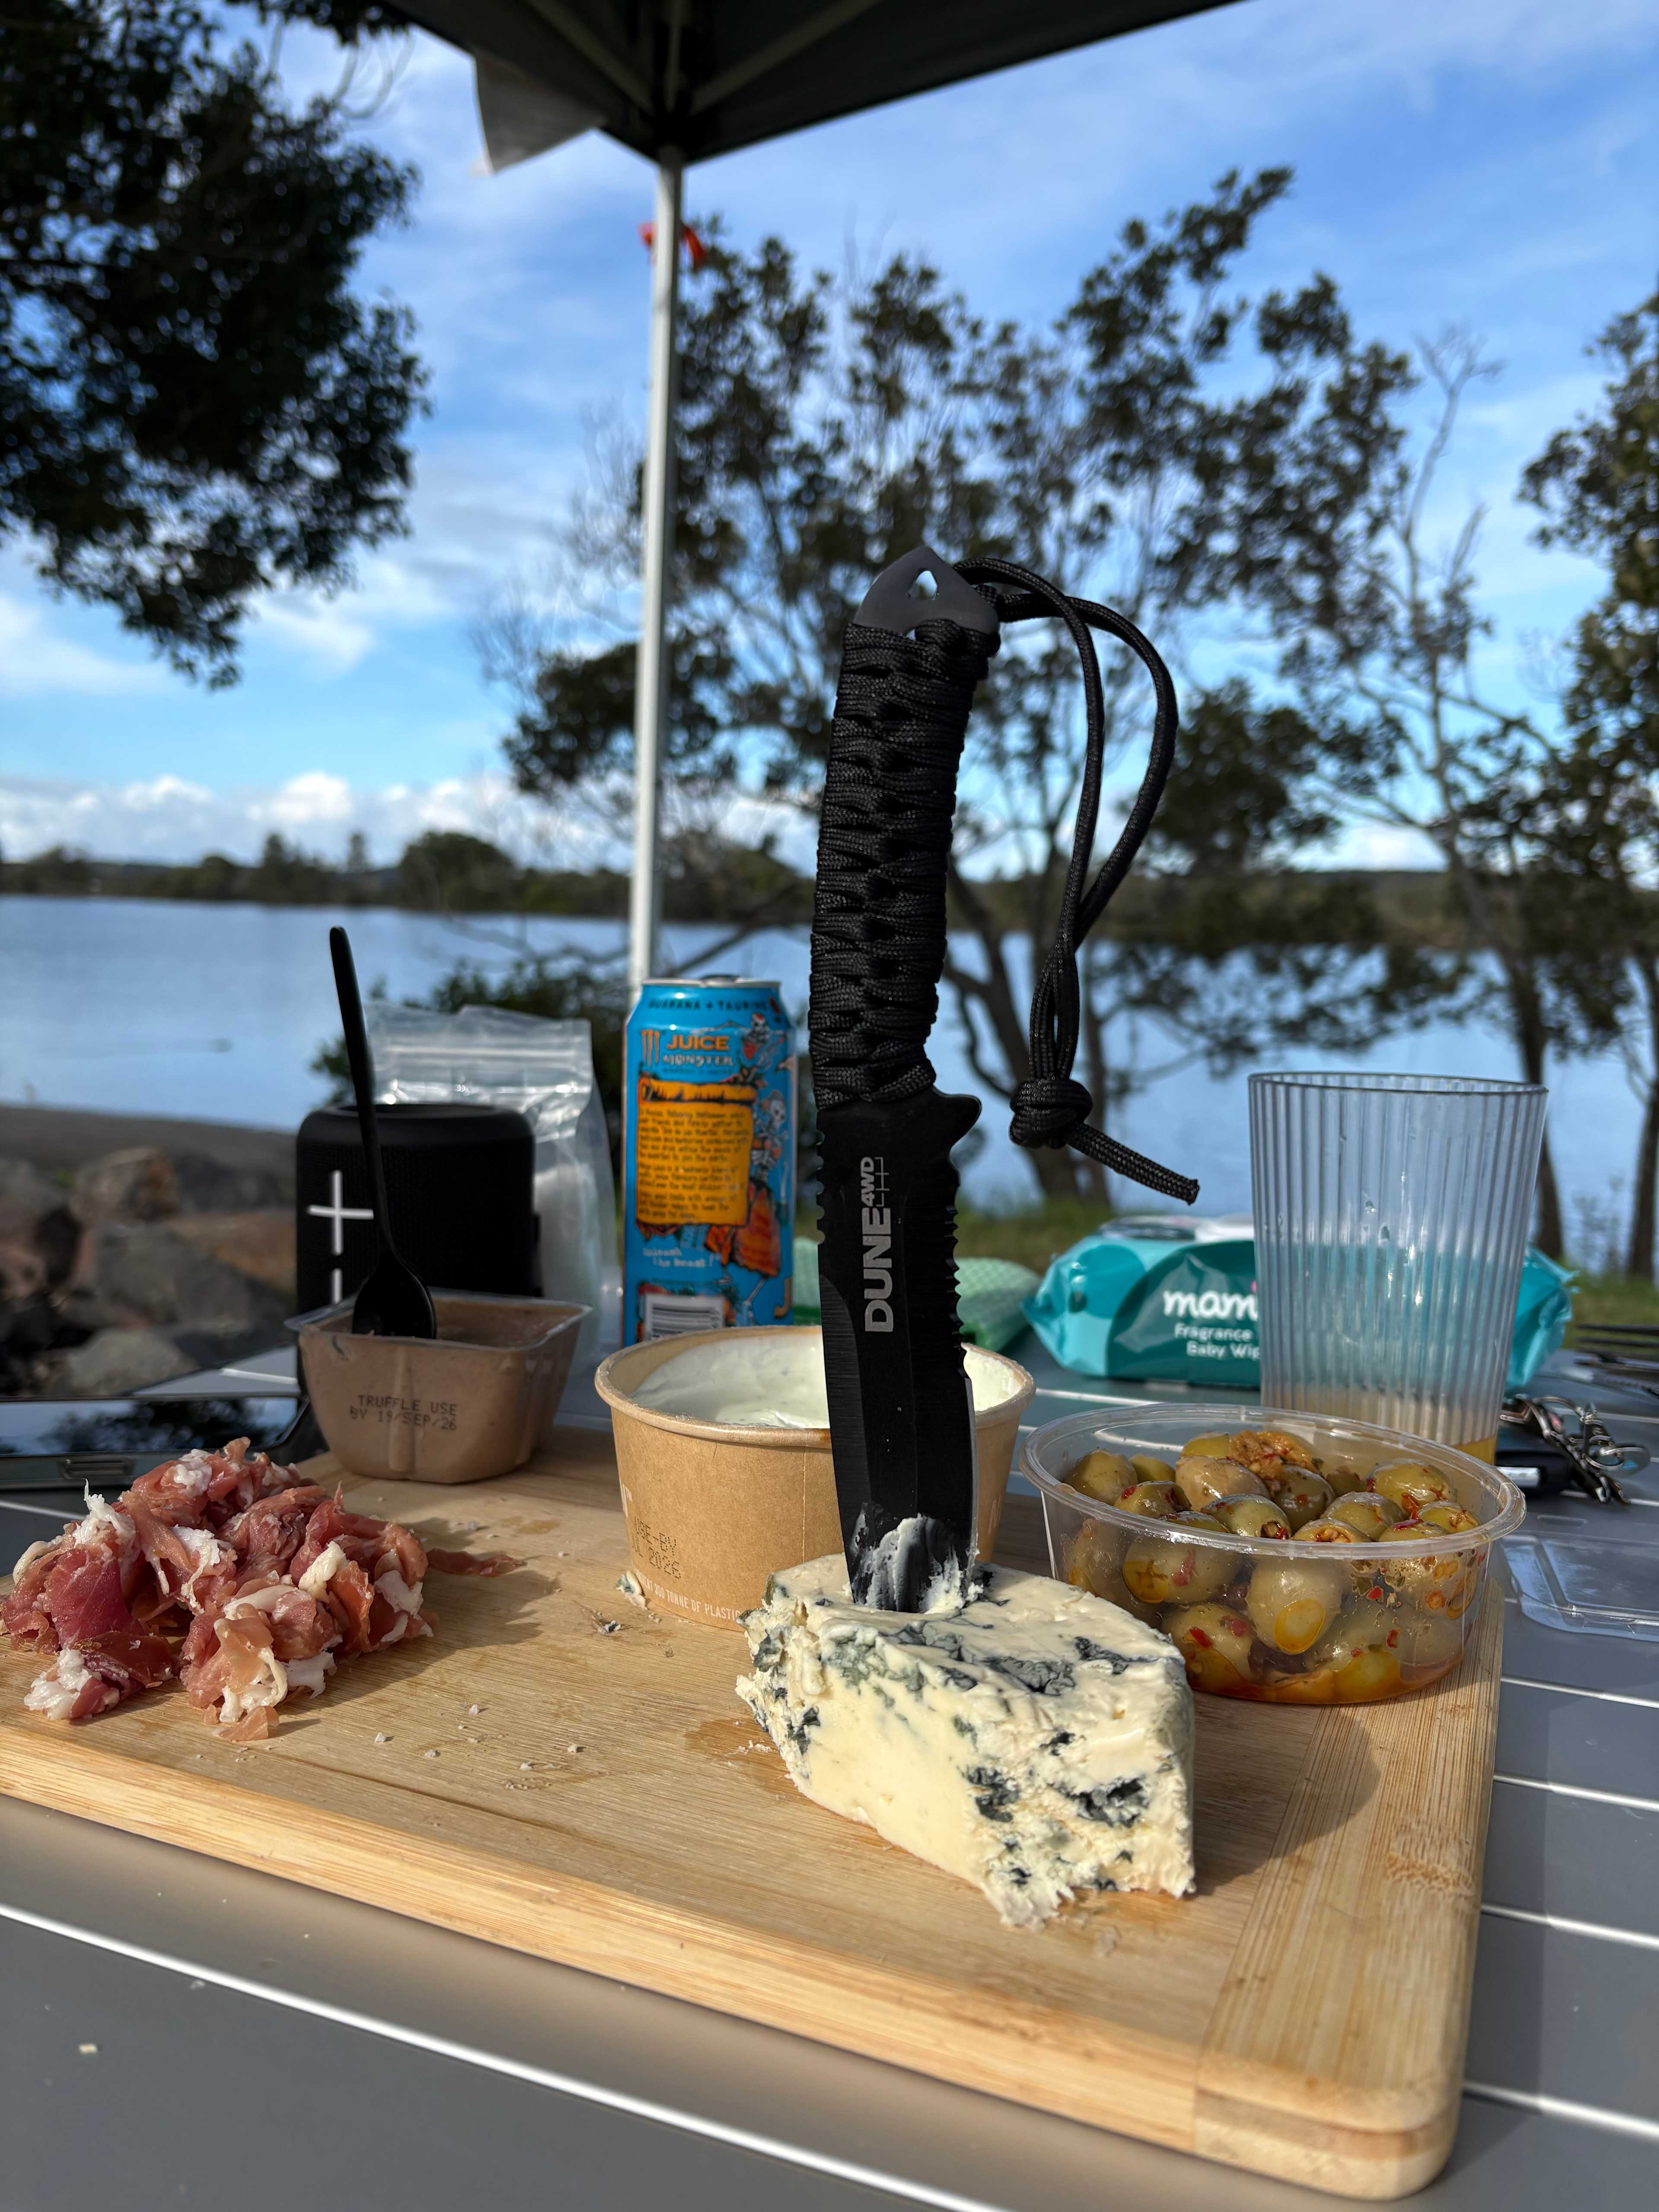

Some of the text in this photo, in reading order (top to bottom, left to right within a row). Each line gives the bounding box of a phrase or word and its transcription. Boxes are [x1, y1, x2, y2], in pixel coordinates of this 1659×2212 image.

[667, 1034, 729, 1051] JUICE
[860, 1156, 894, 1332] DUNE 4WD
[1163, 1290, 1258, 1321] mam
[1174, 1323, 1252, 1343] Fragrance
[1186, 1341, 1260, 1361] Baby Wip
[350, 1405, 367, 1420] BY
[358, 1394, 458, 1417] TRUFFLE USE
[648, 1545, 681, 1580] 2026
[666, 1589, 689, 1609] TONNE
[691, 1599, 701, 1613] OF
